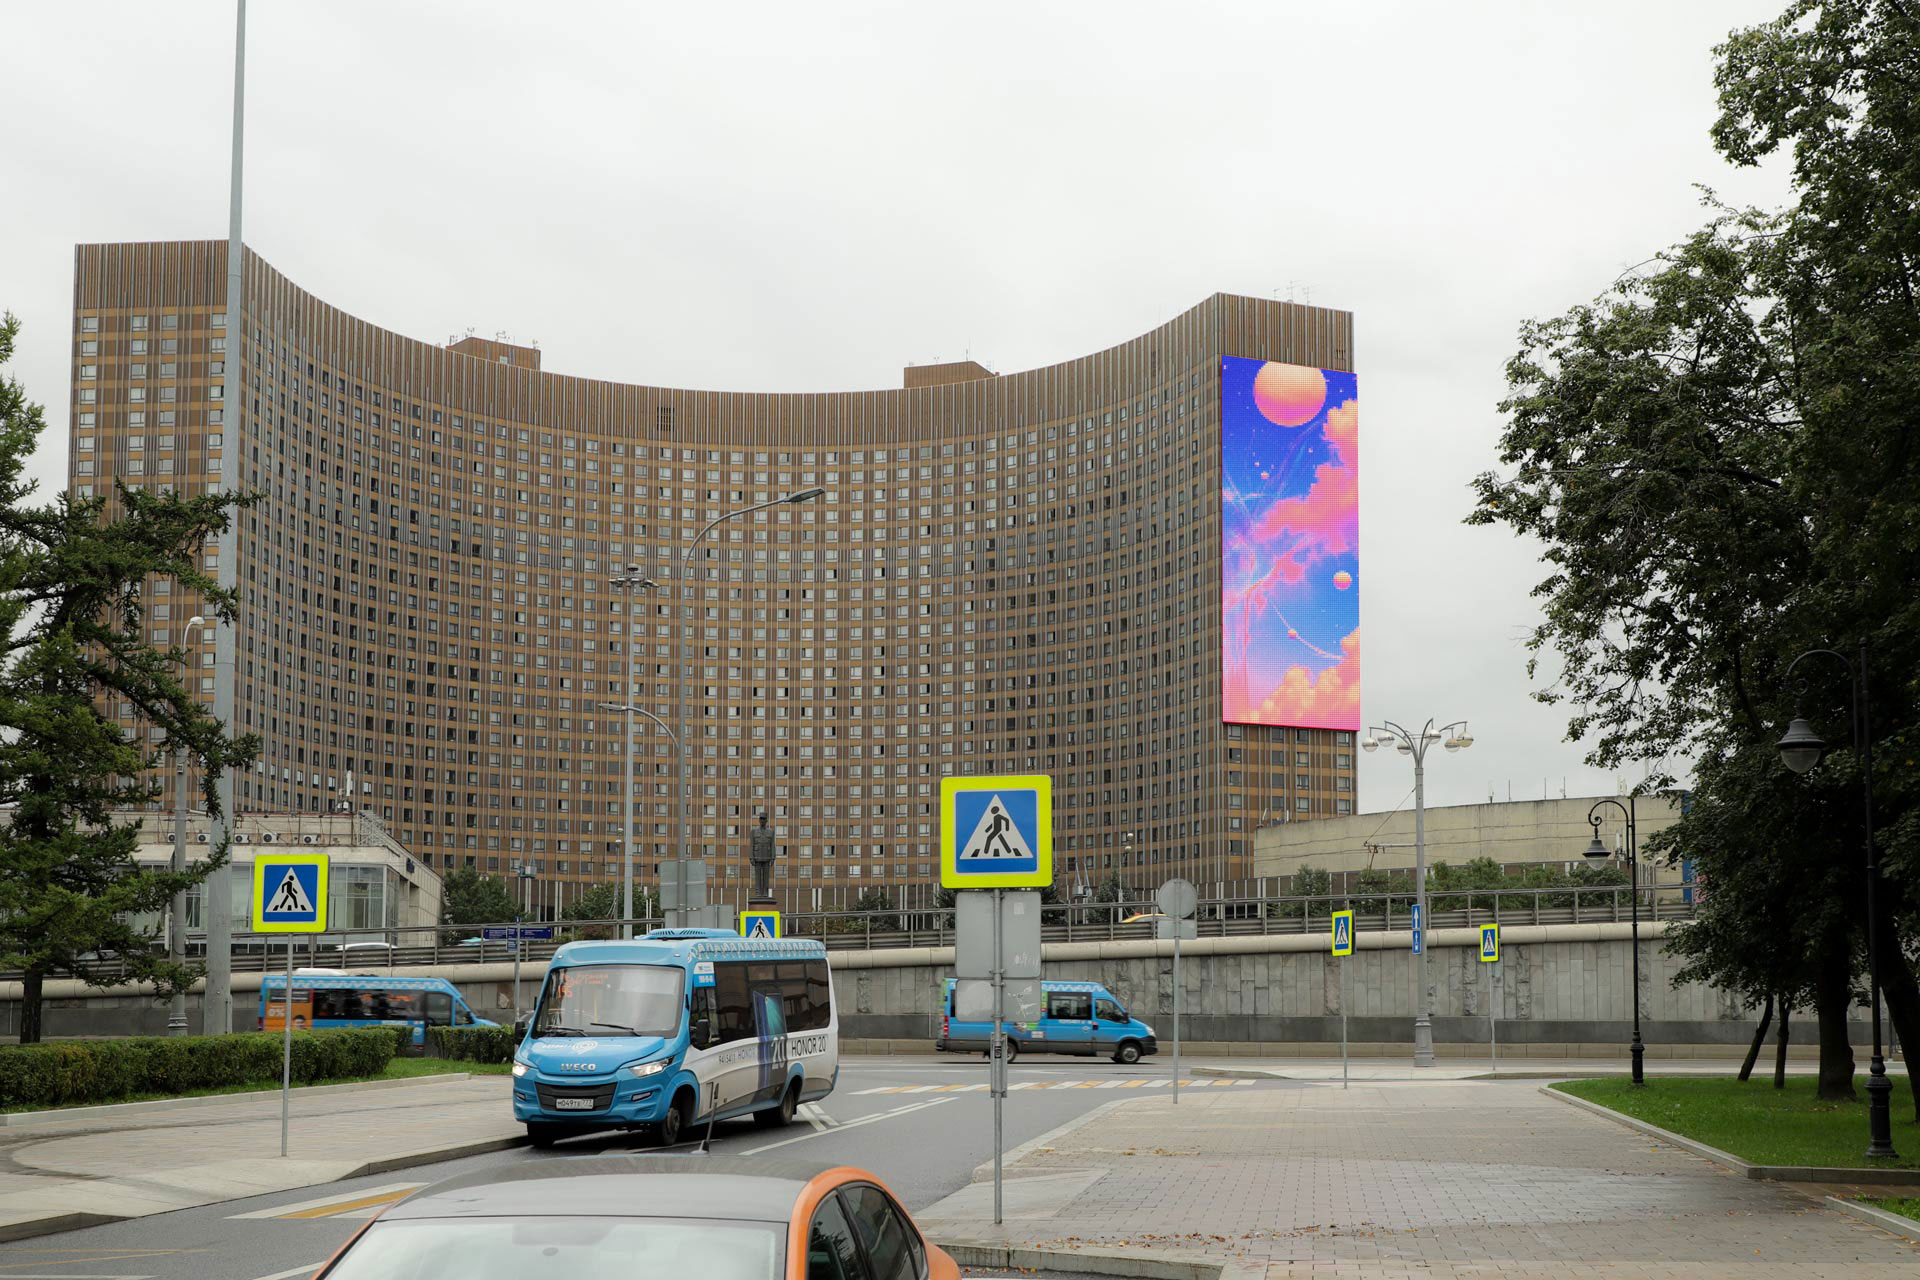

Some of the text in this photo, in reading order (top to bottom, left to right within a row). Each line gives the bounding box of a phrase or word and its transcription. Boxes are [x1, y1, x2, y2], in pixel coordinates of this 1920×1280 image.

[771, 1036, 786, 1070] 20
[791, 1036, 827, 1057] HONOR 20
[560, 1063, 597, 1072] IVECO
